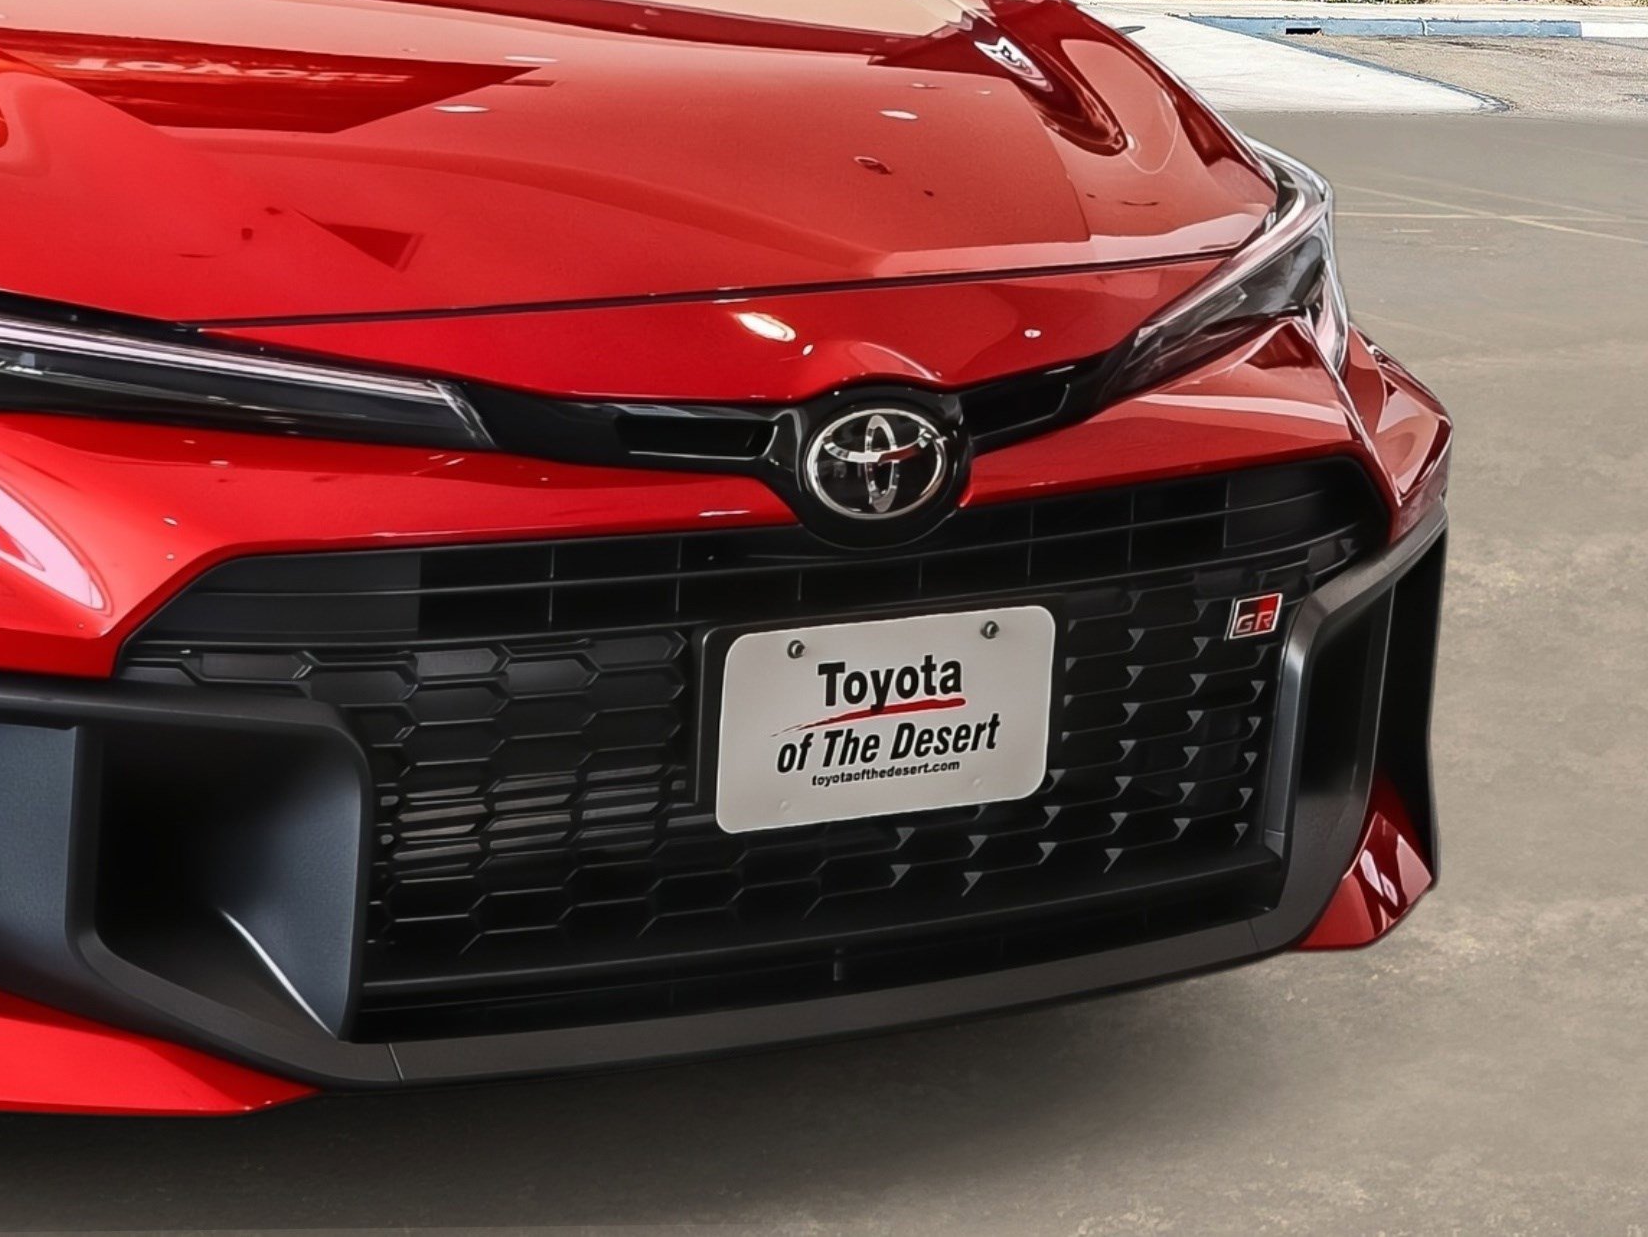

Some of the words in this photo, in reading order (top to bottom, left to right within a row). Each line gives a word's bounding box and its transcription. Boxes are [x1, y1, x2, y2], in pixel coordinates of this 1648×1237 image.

[1235, 609, 1274, 634] GR
[817, 654, 962, 711] Toyota
[776, 732, 814, 774] of
[822, 728, 881, 768] The
[890, 713, 1001, 760] Desert
[811, 759, 961, 787] toyotaofthedesert.com
